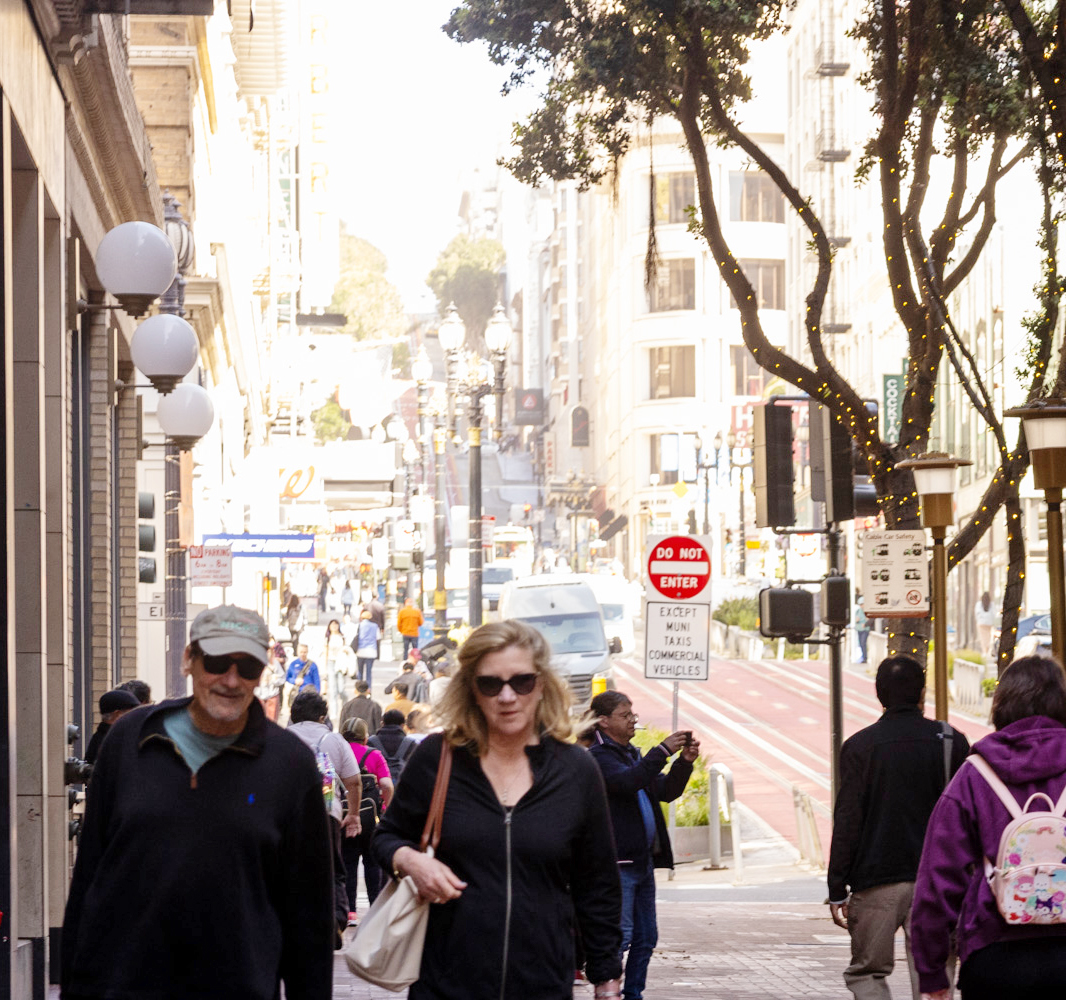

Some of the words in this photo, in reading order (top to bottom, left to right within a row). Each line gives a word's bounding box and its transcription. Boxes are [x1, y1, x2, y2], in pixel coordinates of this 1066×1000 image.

[204, 548, 231, 557] PARKING
[656, 547, 674, 560] DO
[679, 547, 703, 560] NOT
[659, 576, 699, 589] ENTER
[659, 607, 697, 618] EXCEPT
[666, 622, 690, 632] MUNI
[664, 636, 692, 647] TAXIS
[649, 649, 706, 662] COMMERCIAL
[653, 665, 701, 677] VEHICLES
